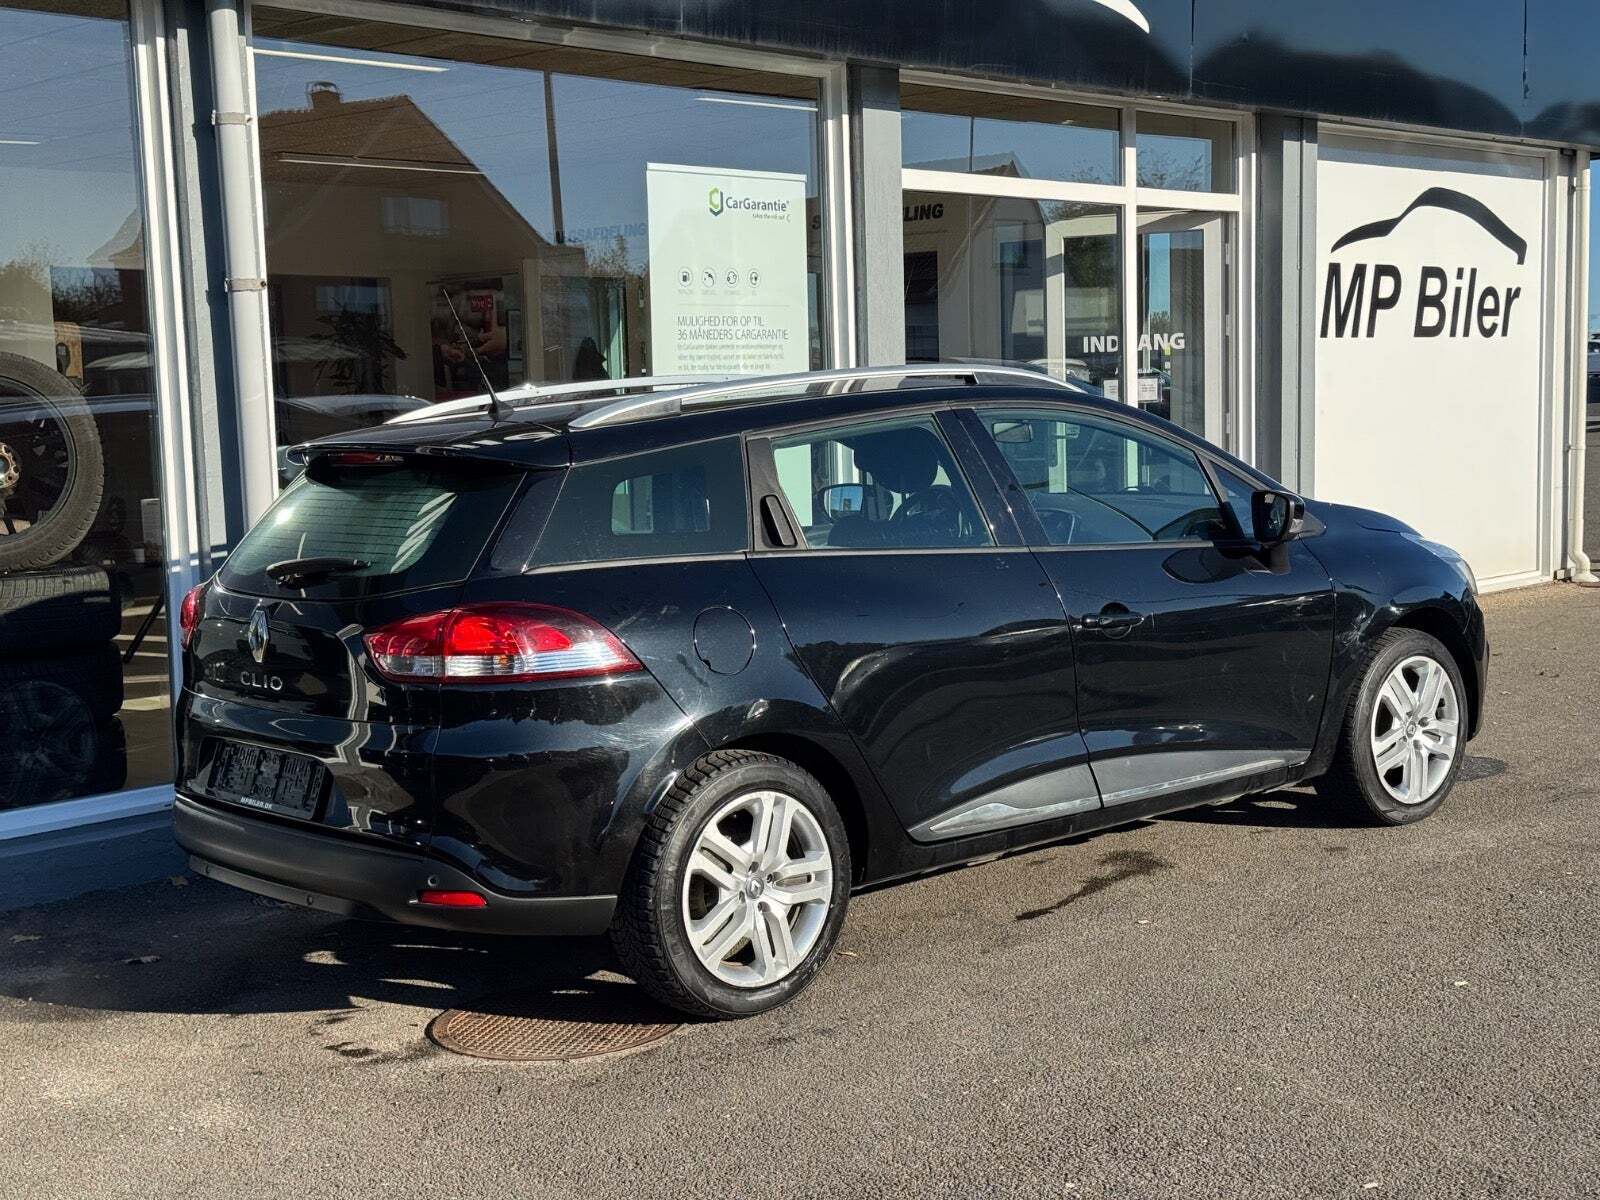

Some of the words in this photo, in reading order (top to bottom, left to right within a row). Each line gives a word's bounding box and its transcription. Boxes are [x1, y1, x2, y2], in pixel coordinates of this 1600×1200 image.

[726, 196, 787, 212] CarGarantie
[1320, 262, 1402, 339] MP
[1413, 265, 1521, 339] Biler
[677, 314, 721, 327] MULIGHED
[722, 315, 739, 327] FOR
[740, 315, 752, 327] OP
[753, 315, 765, 327] TIL
[677, 329, 688, 341] 36
[689, 327, 733, 341] MÅNEDERS
[734, 328, 790, 341] CARGARANTIE
[1083, 332, 1186, 353] INDANG
[240, 671, 283, 691] CLIO
